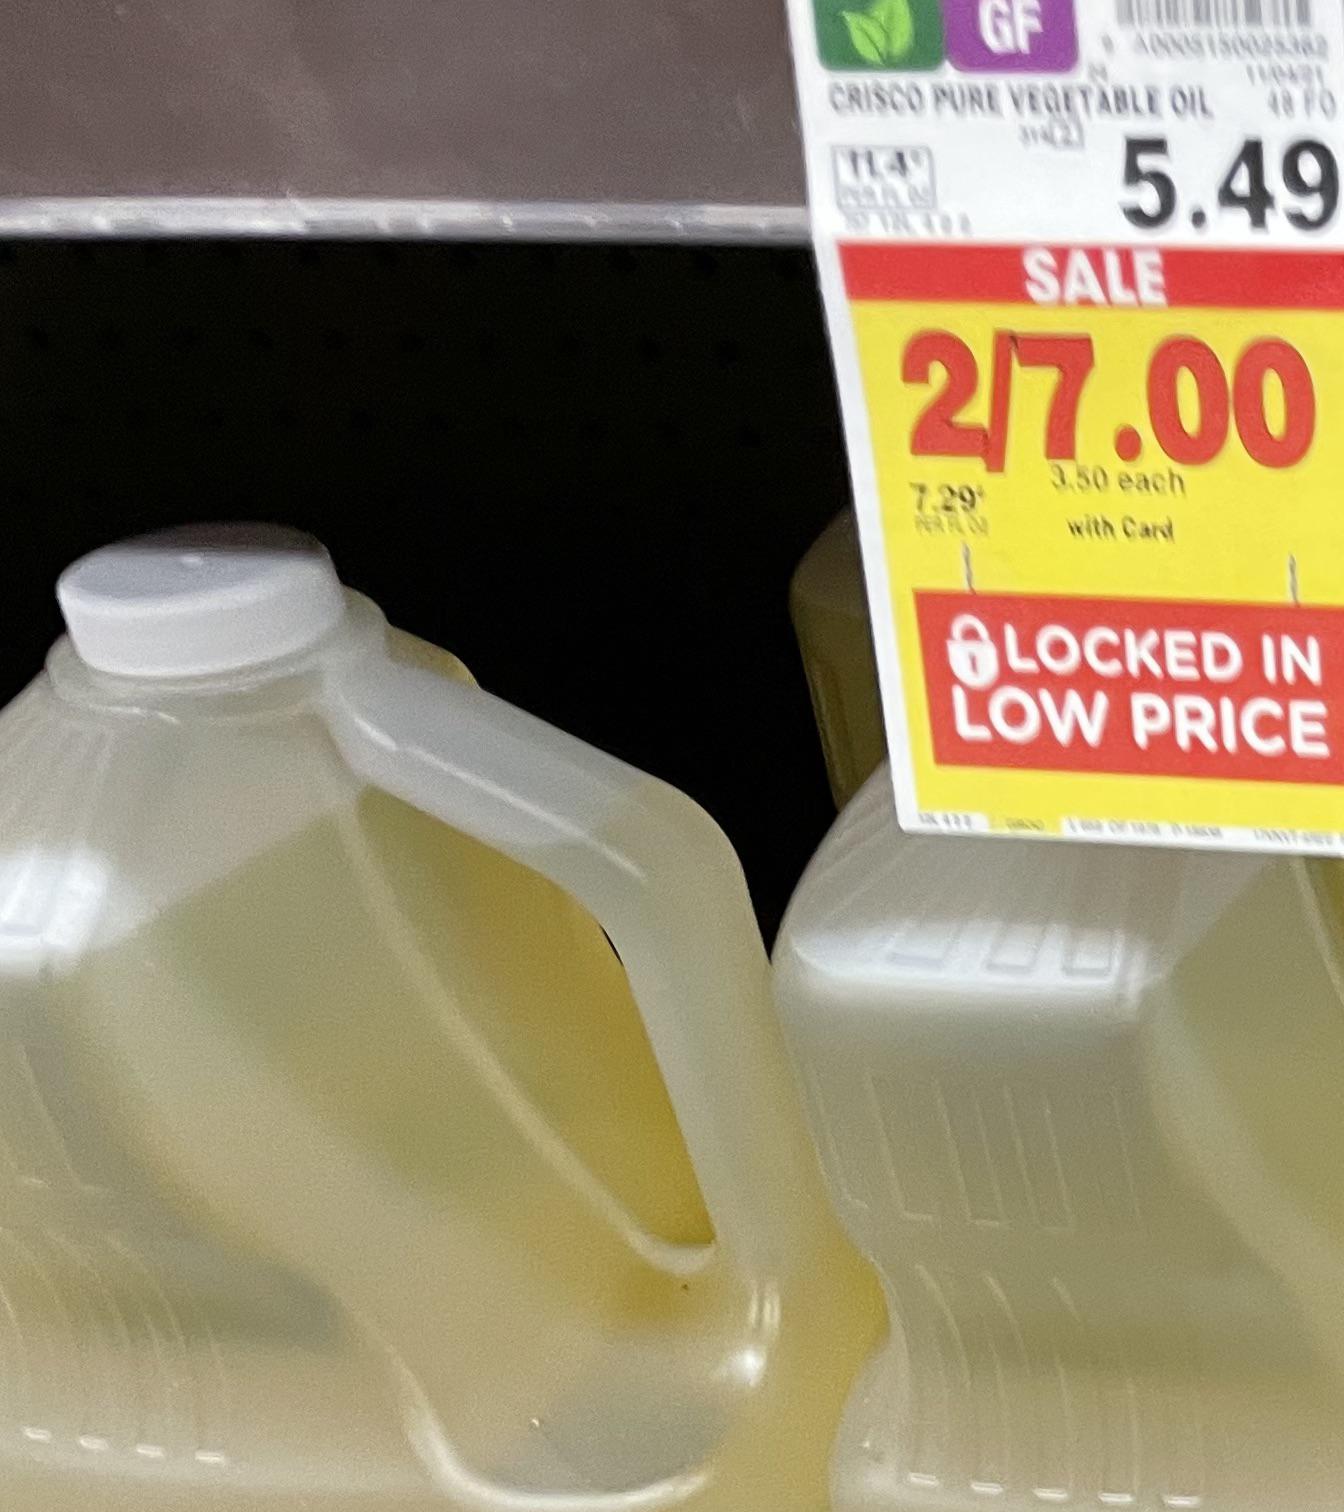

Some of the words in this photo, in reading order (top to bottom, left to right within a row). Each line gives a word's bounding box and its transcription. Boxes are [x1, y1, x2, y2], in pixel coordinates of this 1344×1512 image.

[978, 0, 1043, 54] GF
[829, 79, 923, 115] CRISCO
[932, 80, 1003, 117] PURE
[1009, 82, 1161, 119] VEGETABLE
[1171, 85, 1213, 119] OIL
[1120, 136, 1340, 231] 5.49
[1022, 247, 1168, 308] SALE
[901, 328, 1315, 474] 2/7.00
[1051, 463, 1109, 492] 3.50
[1117, 467, 1186, 497] each
[1068, 515, 1116, 538] with
[1122, 516, 1175, 543] Card
[1003, 622, 1243, 684] LOCKED
[1261, 633, 1322, 686] IN
[951, 685, 1110, 748] LOW
[1130, 691, 1332, 760] PRICE
